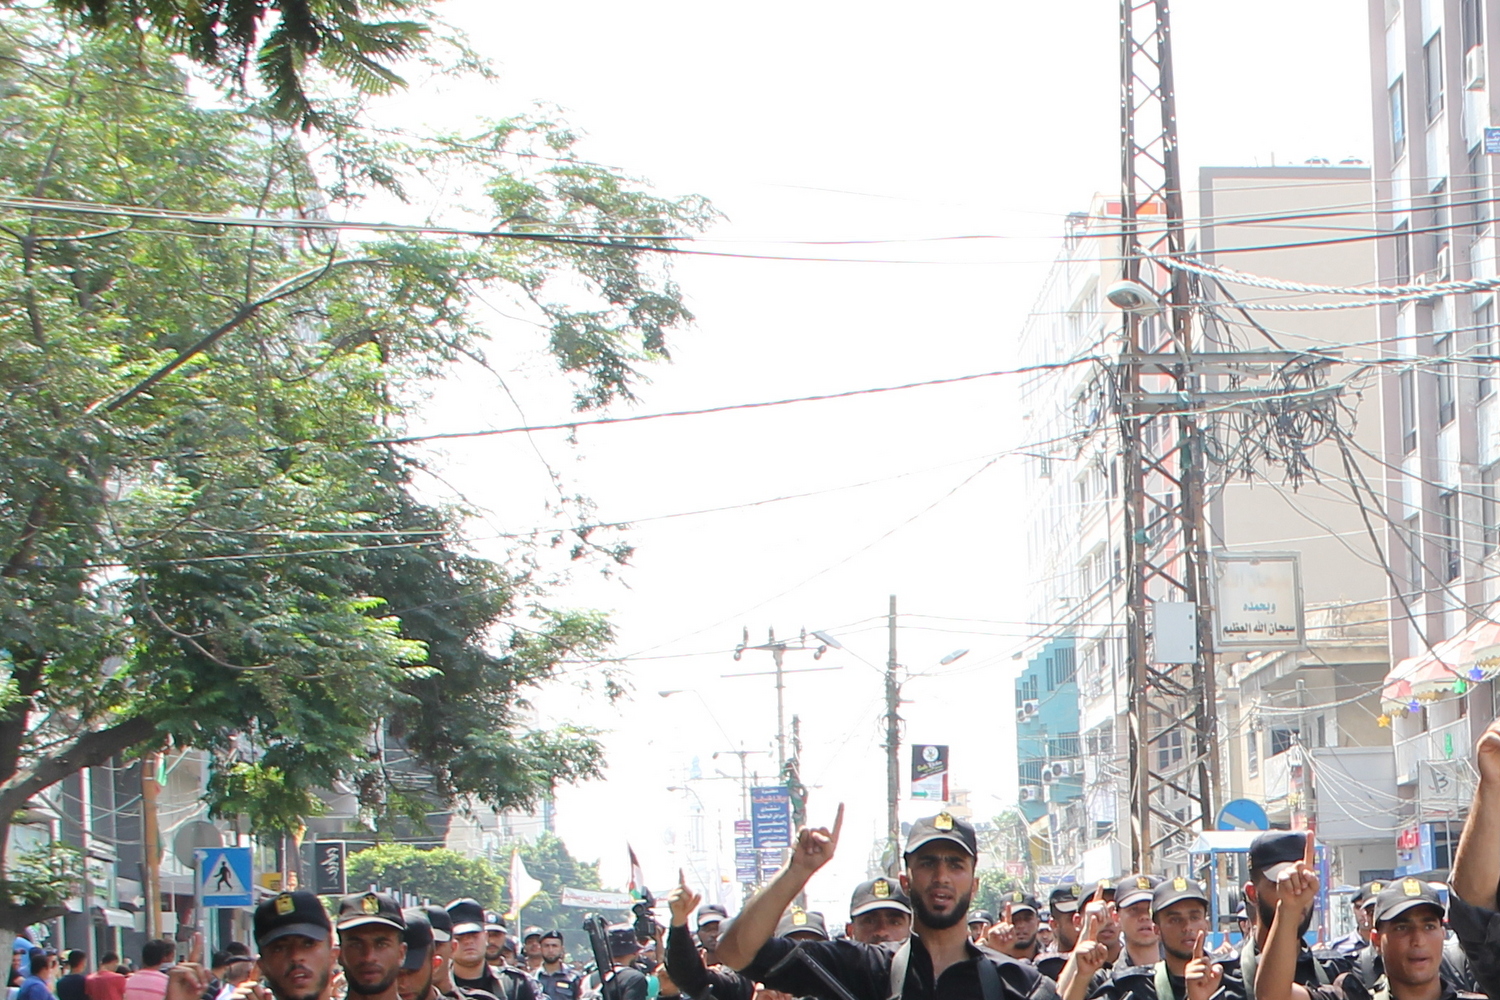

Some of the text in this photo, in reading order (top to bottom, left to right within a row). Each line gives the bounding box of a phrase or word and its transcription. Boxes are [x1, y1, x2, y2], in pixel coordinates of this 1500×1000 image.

[1222, 620, 1296, 637] سبحان الله العظيم
